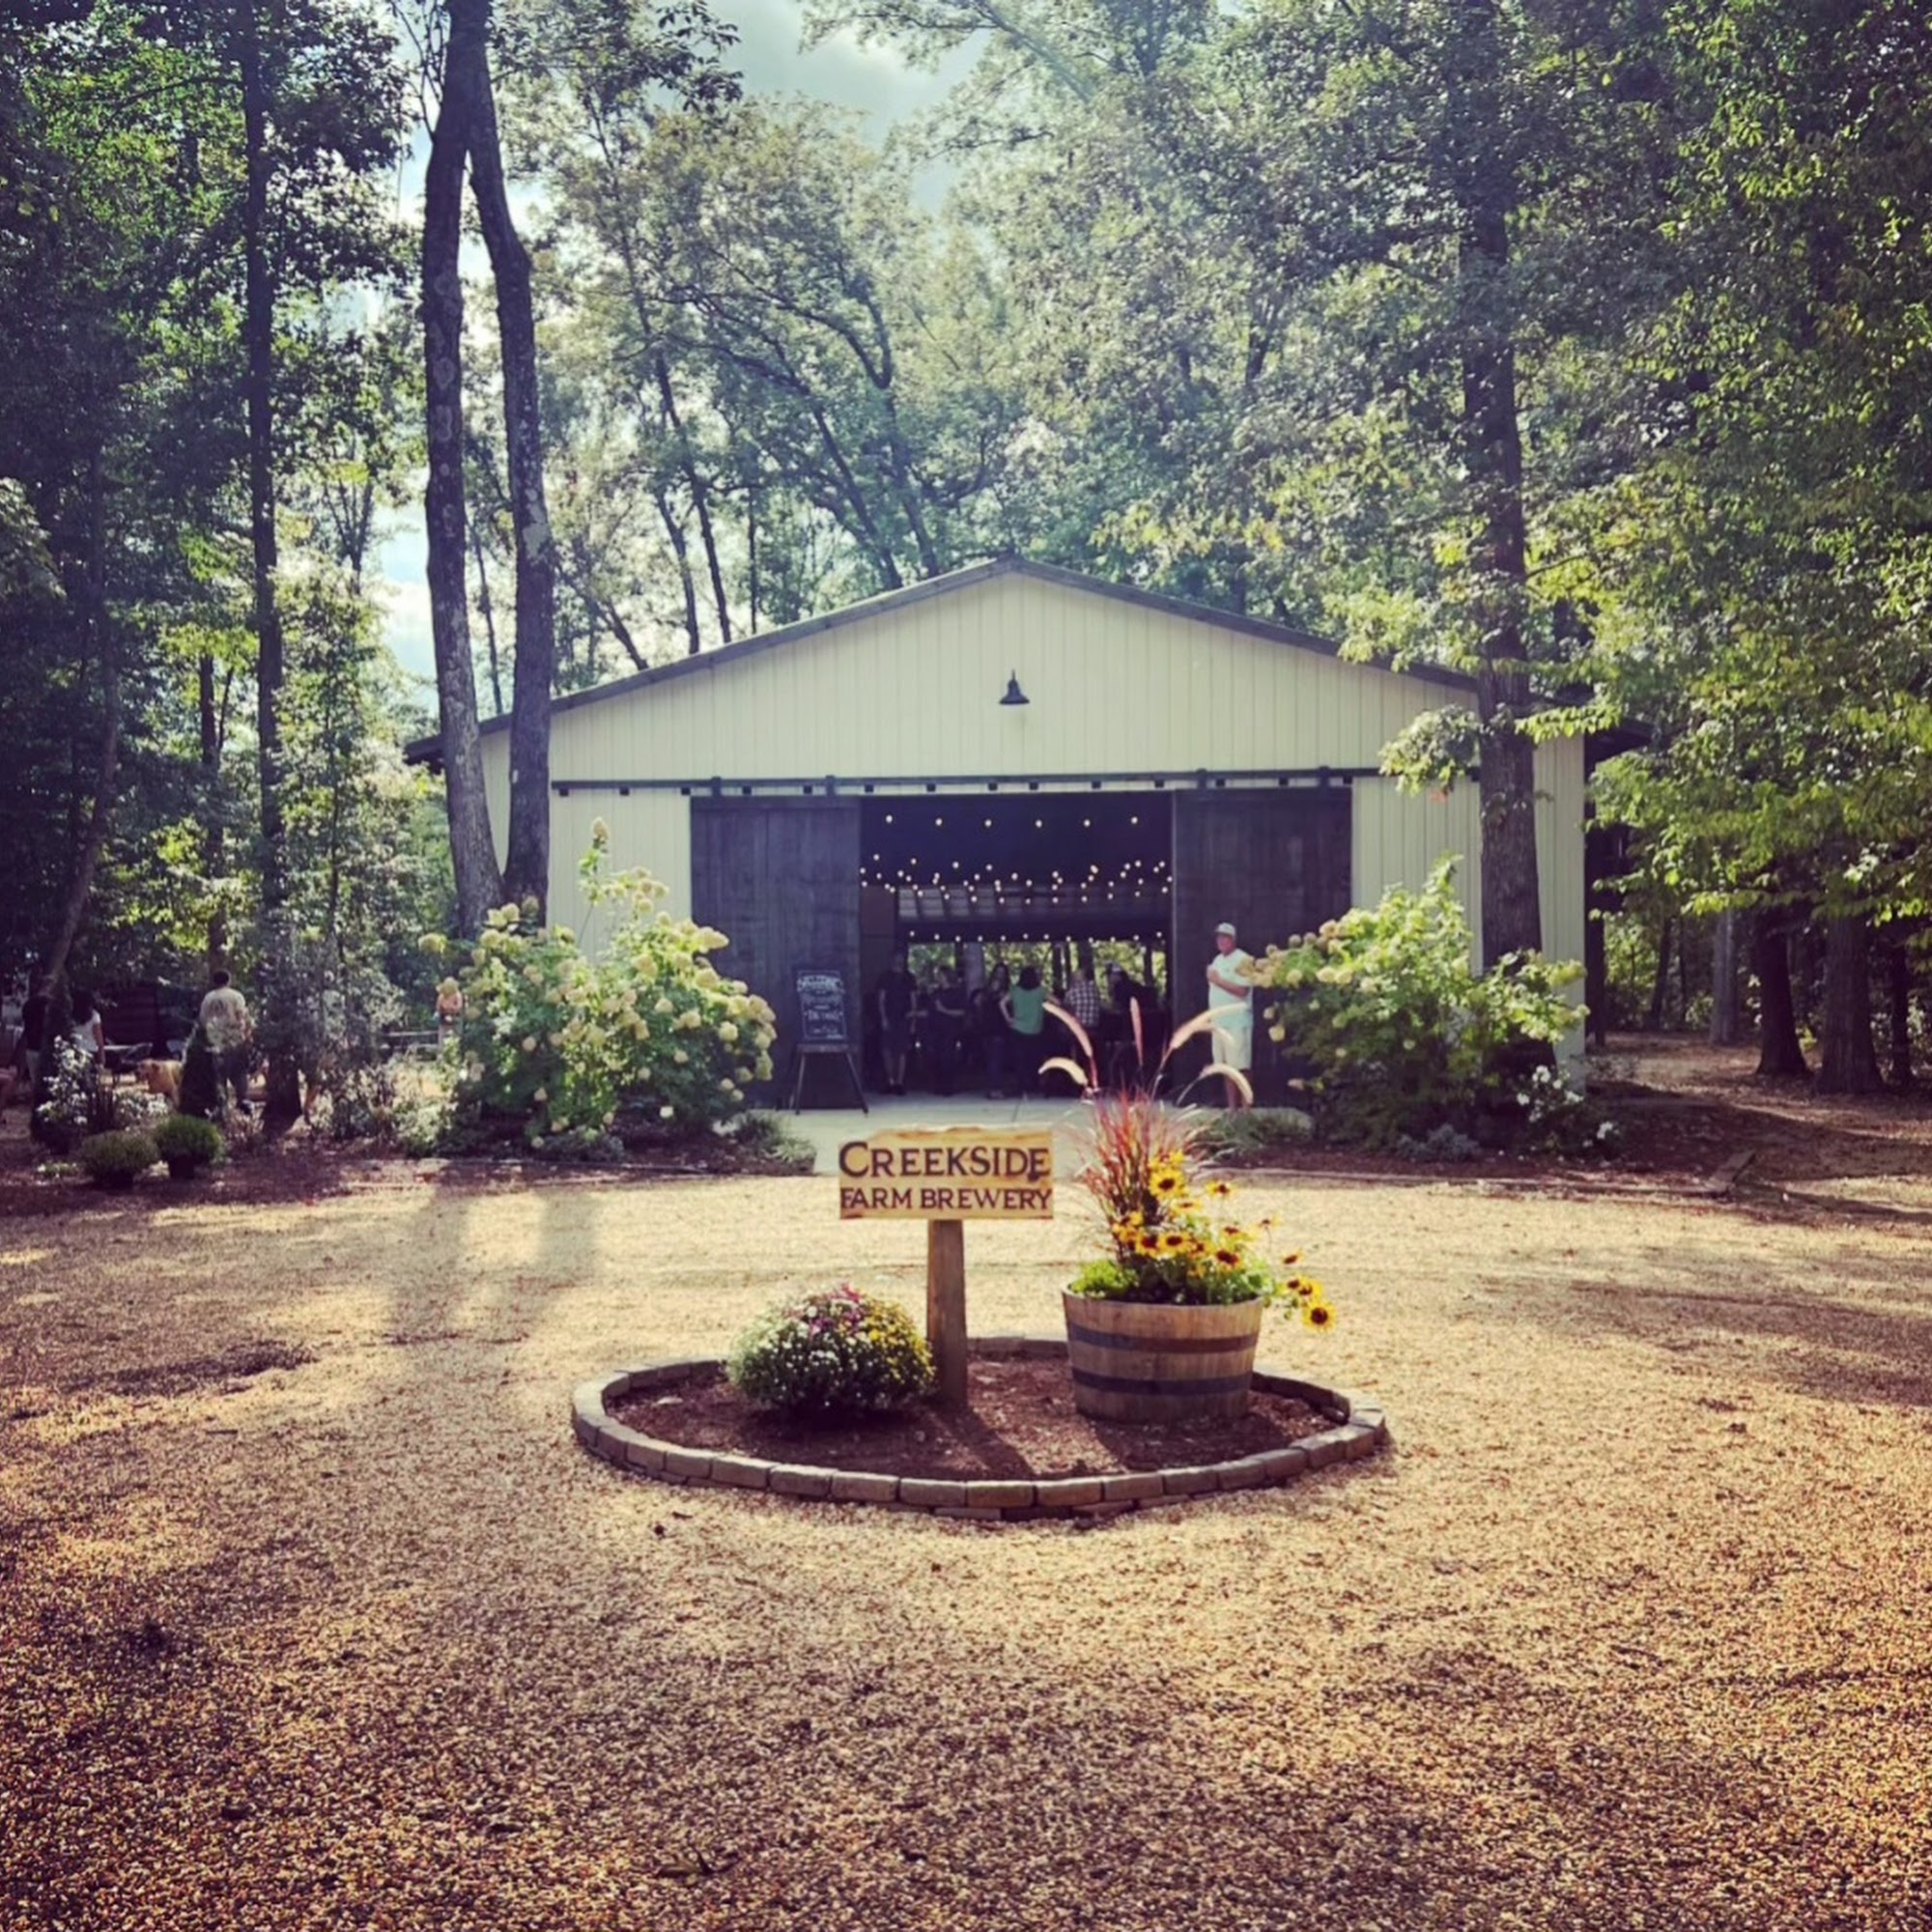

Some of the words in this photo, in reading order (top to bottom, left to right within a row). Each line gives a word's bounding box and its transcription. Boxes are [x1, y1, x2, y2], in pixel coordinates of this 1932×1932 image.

[838, 1141, 1051, 1179] CREEKSIDE
[839, 1187, 913, 1208] FARM
[920, 1187, 1053, 1209] BREWERY
